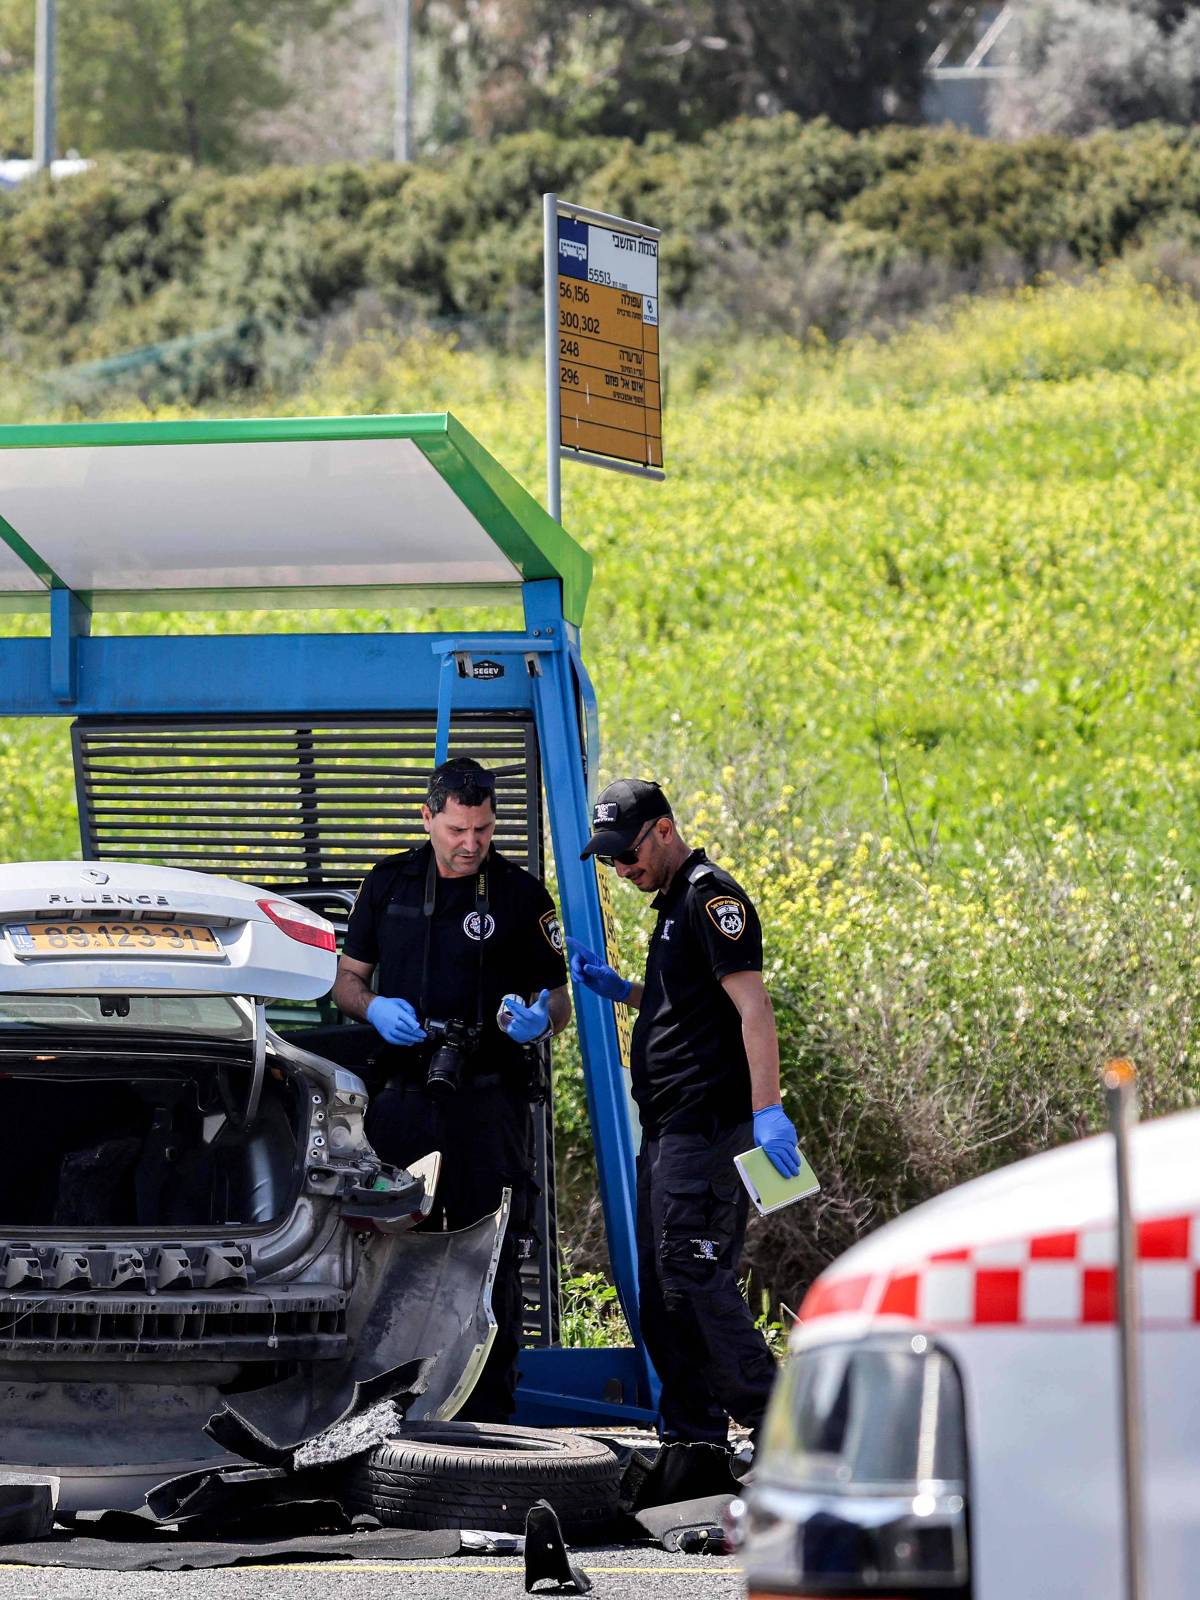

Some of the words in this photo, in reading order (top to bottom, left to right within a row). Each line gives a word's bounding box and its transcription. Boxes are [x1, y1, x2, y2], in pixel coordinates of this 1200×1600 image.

[612, 234, 637, 252] התשבי
[638, 241, 657, 257] צומת
[588, 268, 611, 285] 55513
[560, 282, 590, 303] 56,156
[621, 293, 642, 308] עפולה
[560, 310, 600, 335] 300,302
[560, 339, 580, 357] 248
[561, 367, 580, 385] 296
[605, 375, 619, 387] פחם
[620, 376, 630, 389] אל
[473, 667, 499, 675] SEGEV
[48, 893, 170, 906] FLUENCE
[15, 935, 30, 945] IL
